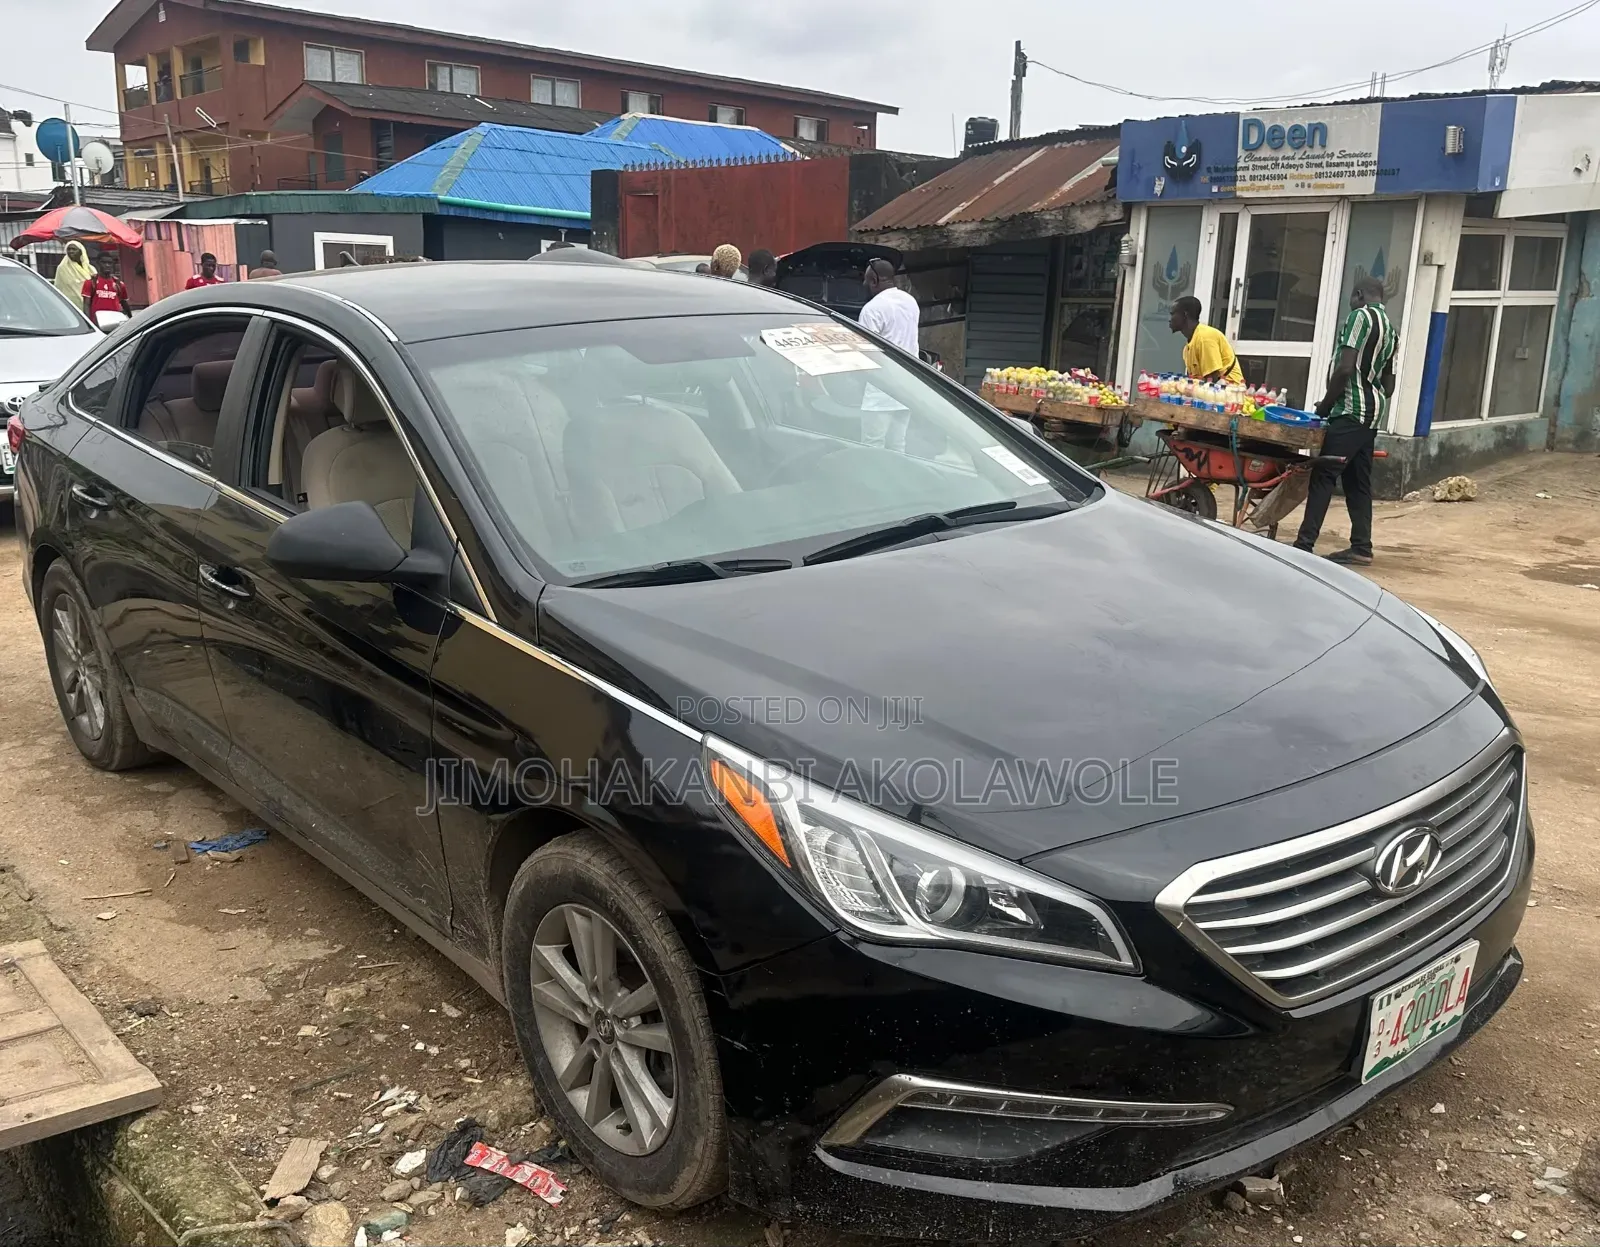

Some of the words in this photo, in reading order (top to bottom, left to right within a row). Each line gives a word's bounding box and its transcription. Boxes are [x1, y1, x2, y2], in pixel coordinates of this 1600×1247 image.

[1241, 118, 1328, 151] Deen
[1281, 152, 1297, 161] and
[1337, 149, 1373, 160] Services
[1357, 160, 1378, 169] Lagos
[1389, 965, 1470, 1047] 4201DLA
